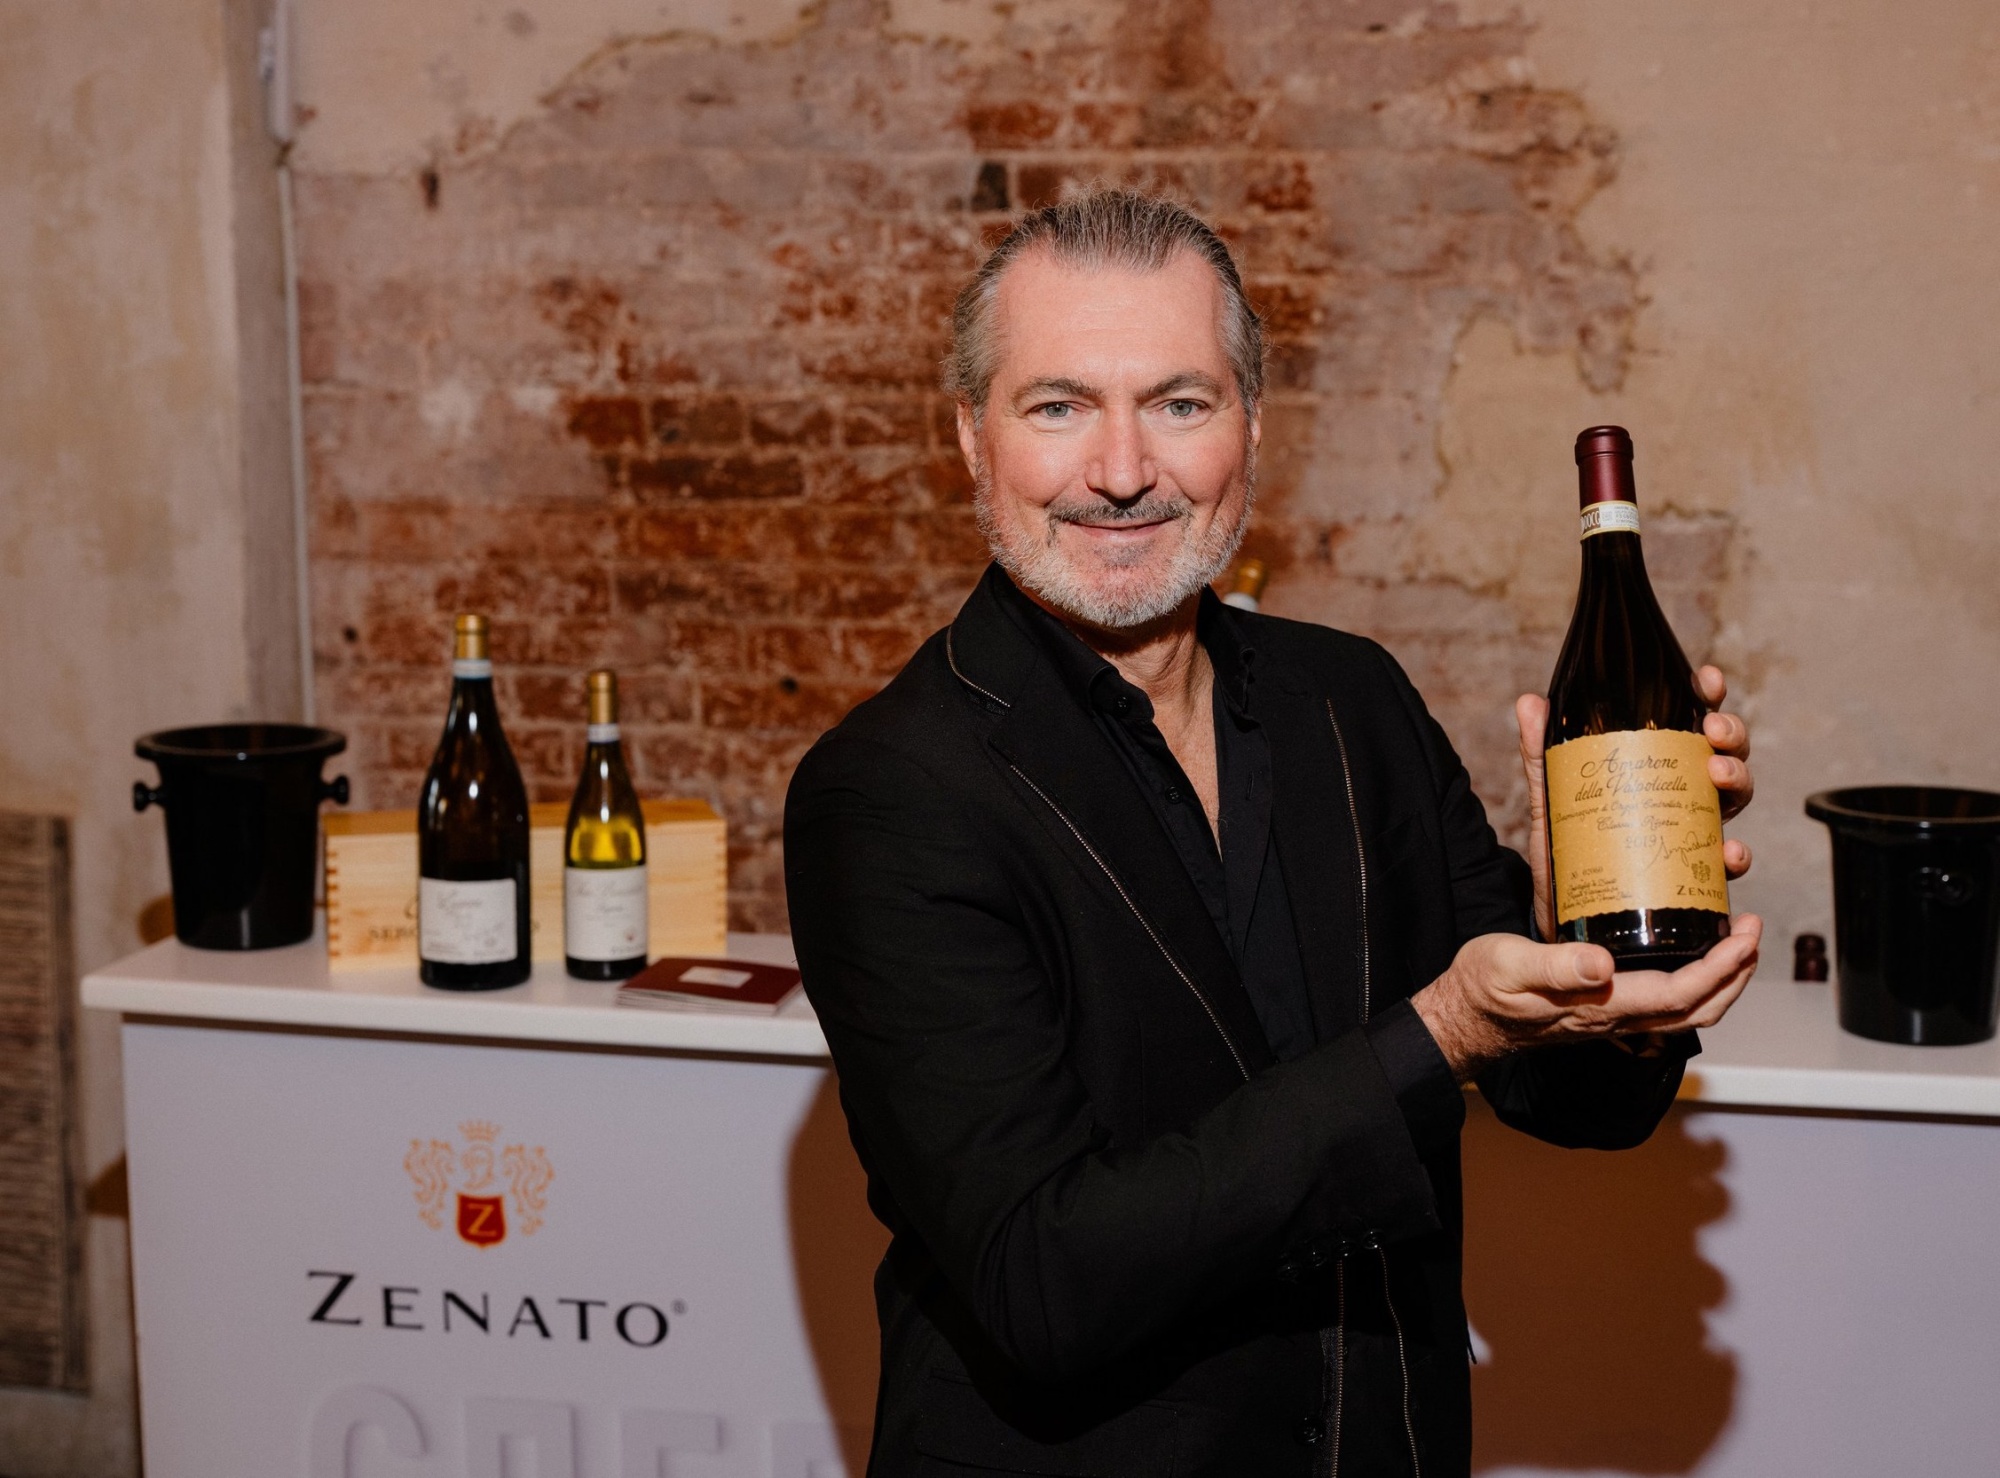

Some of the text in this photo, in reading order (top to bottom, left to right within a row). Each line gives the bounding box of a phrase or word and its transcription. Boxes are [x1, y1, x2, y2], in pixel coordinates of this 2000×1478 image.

[1581, 747, 1679, 778] Amarone
[1575, 772, 1688, 802] della Valpolicella
[1676, 884, 1724, 900] ZENATO
[466, 1202, 499, 1238] Z
